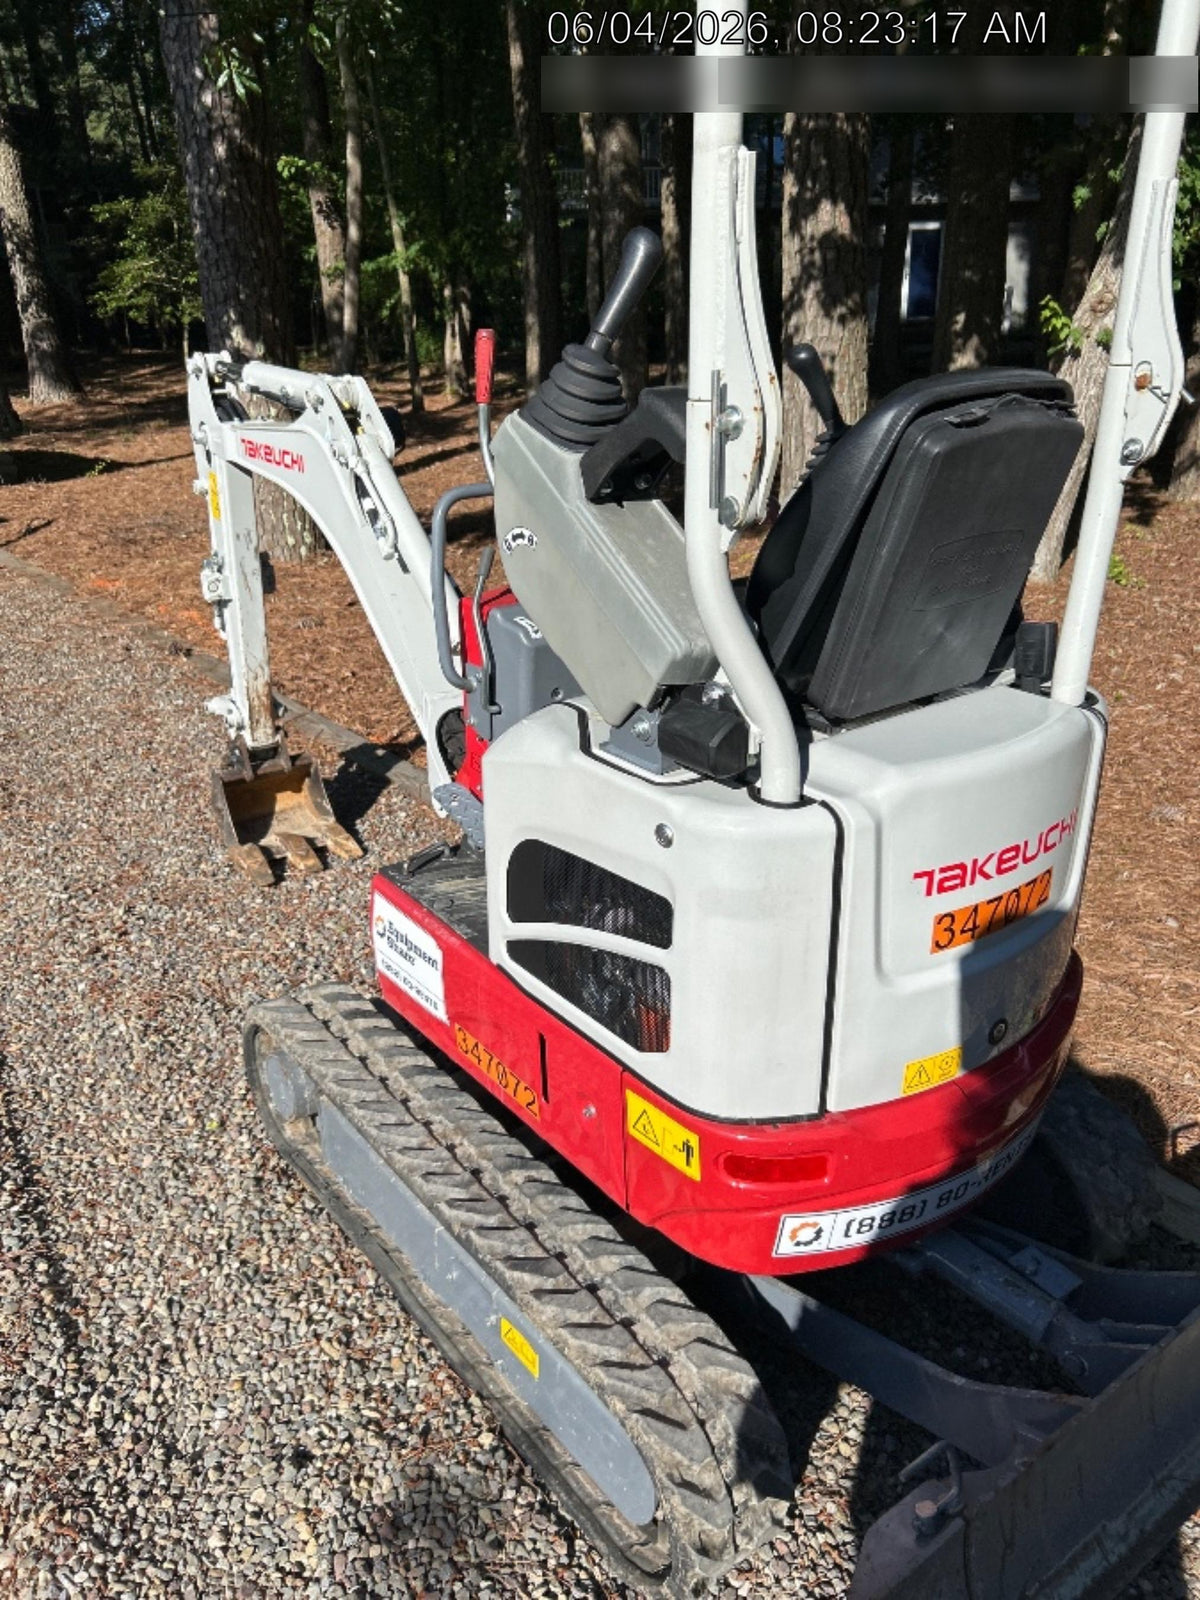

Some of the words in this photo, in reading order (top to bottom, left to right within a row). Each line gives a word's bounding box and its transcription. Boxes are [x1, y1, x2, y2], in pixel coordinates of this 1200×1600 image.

[240, 438, 305, 474] TAKEUCHI
[933, 868, 1052, 951] 347072
[457, 1027, 539, 1117] 347072
[844, 1199, 928, 1239] (888)
